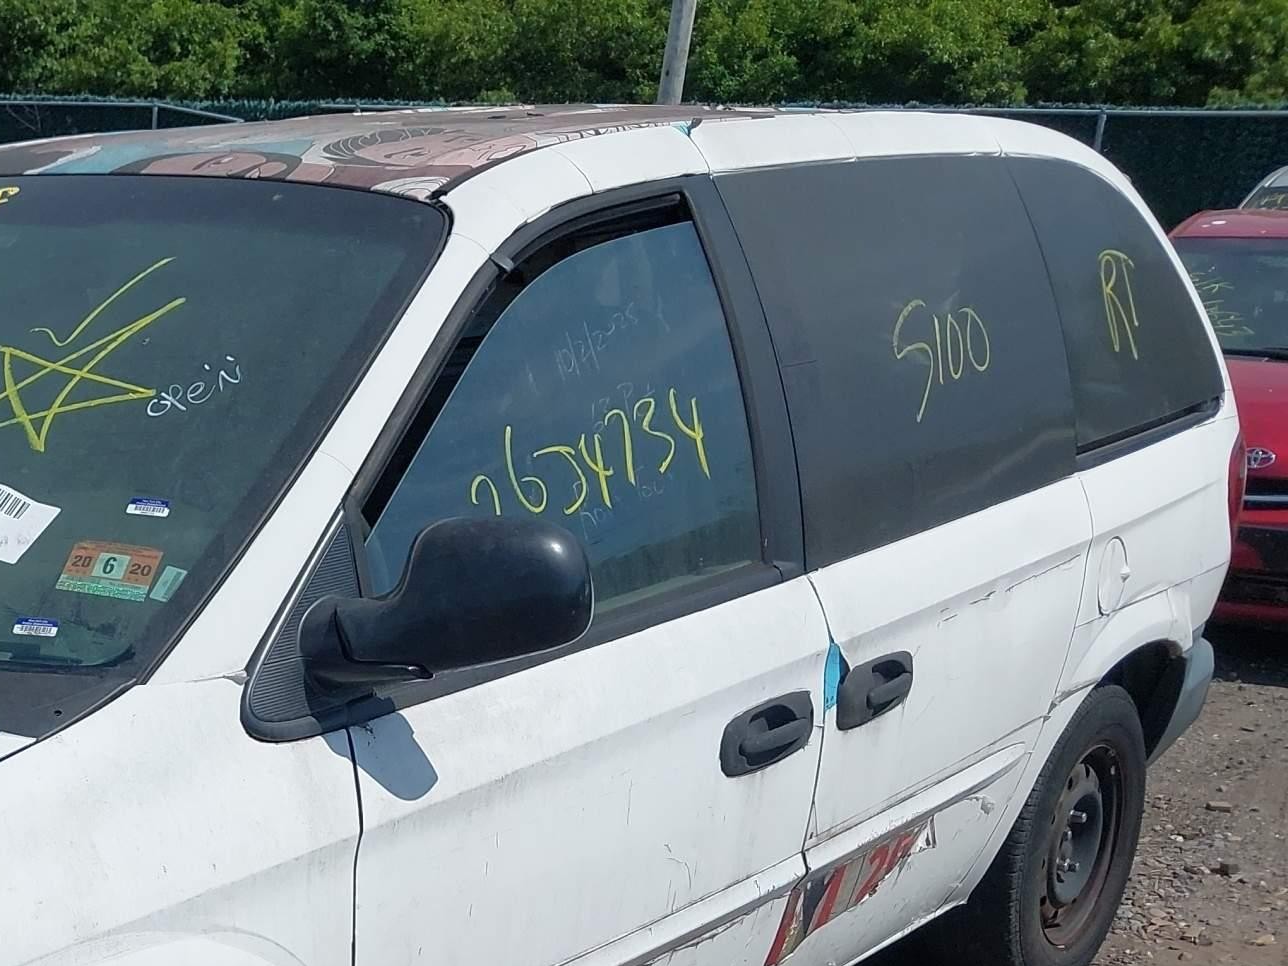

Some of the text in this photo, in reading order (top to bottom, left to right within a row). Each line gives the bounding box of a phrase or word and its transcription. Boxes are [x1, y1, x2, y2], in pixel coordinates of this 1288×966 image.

[892, 298, 991, 423] S100
[1098, 249, 1140, 361] RT
[72, 554, 153, 577] 20 6 20
